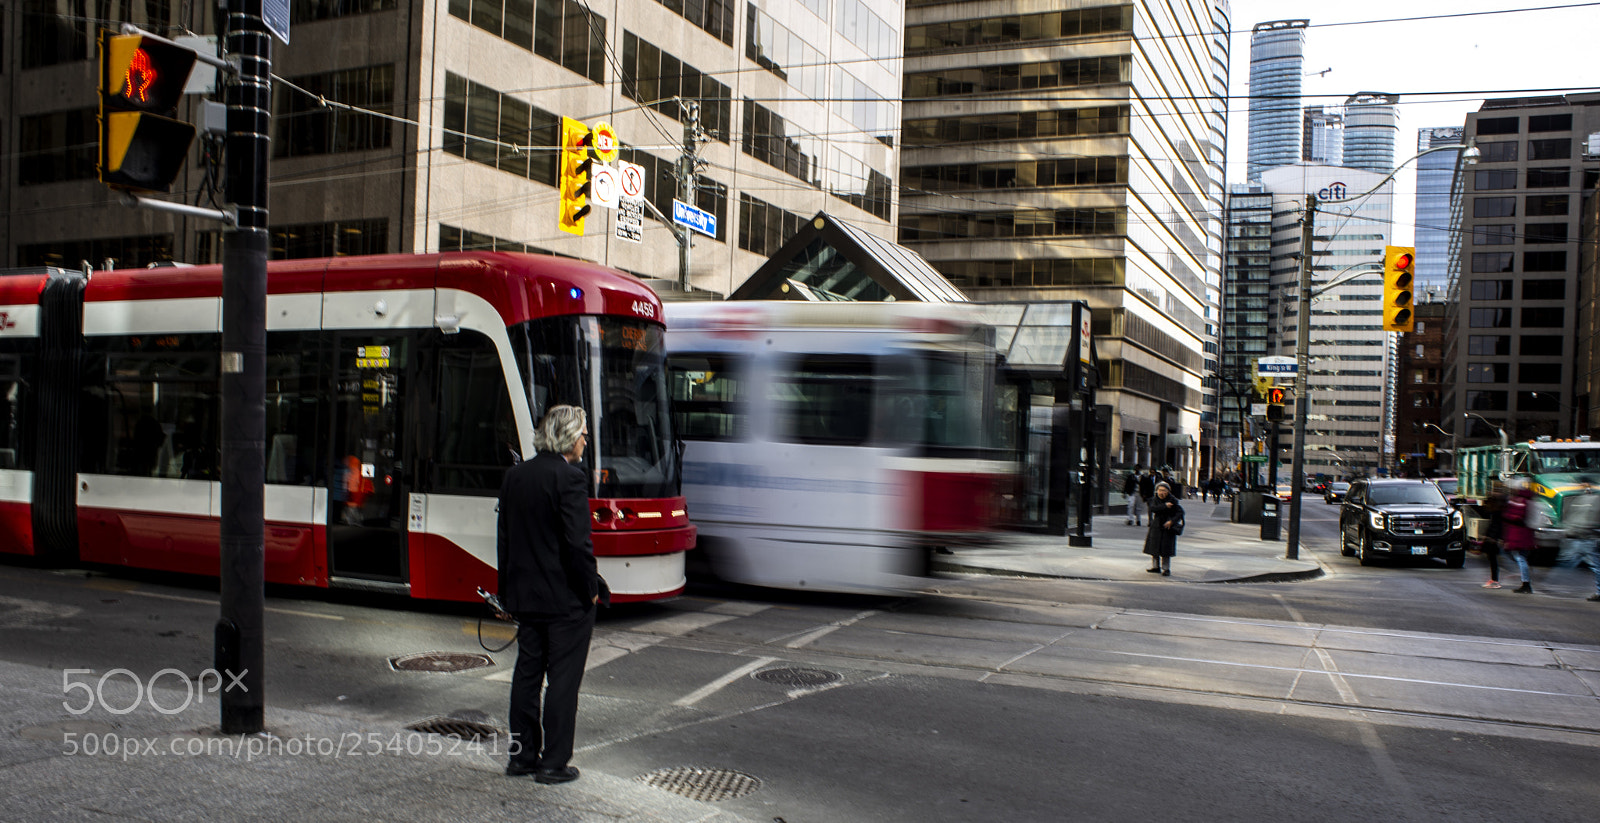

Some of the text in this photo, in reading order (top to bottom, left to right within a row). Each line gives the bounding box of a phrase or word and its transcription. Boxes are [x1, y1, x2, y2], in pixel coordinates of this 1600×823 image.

[597, 133, 613, 149] NEW
[1319, 184, 1346, 200] citi
[675, 202, 708, 231] University
[631, 300, 655, 318] 4459
[1266, 364, 1280, 372] King
